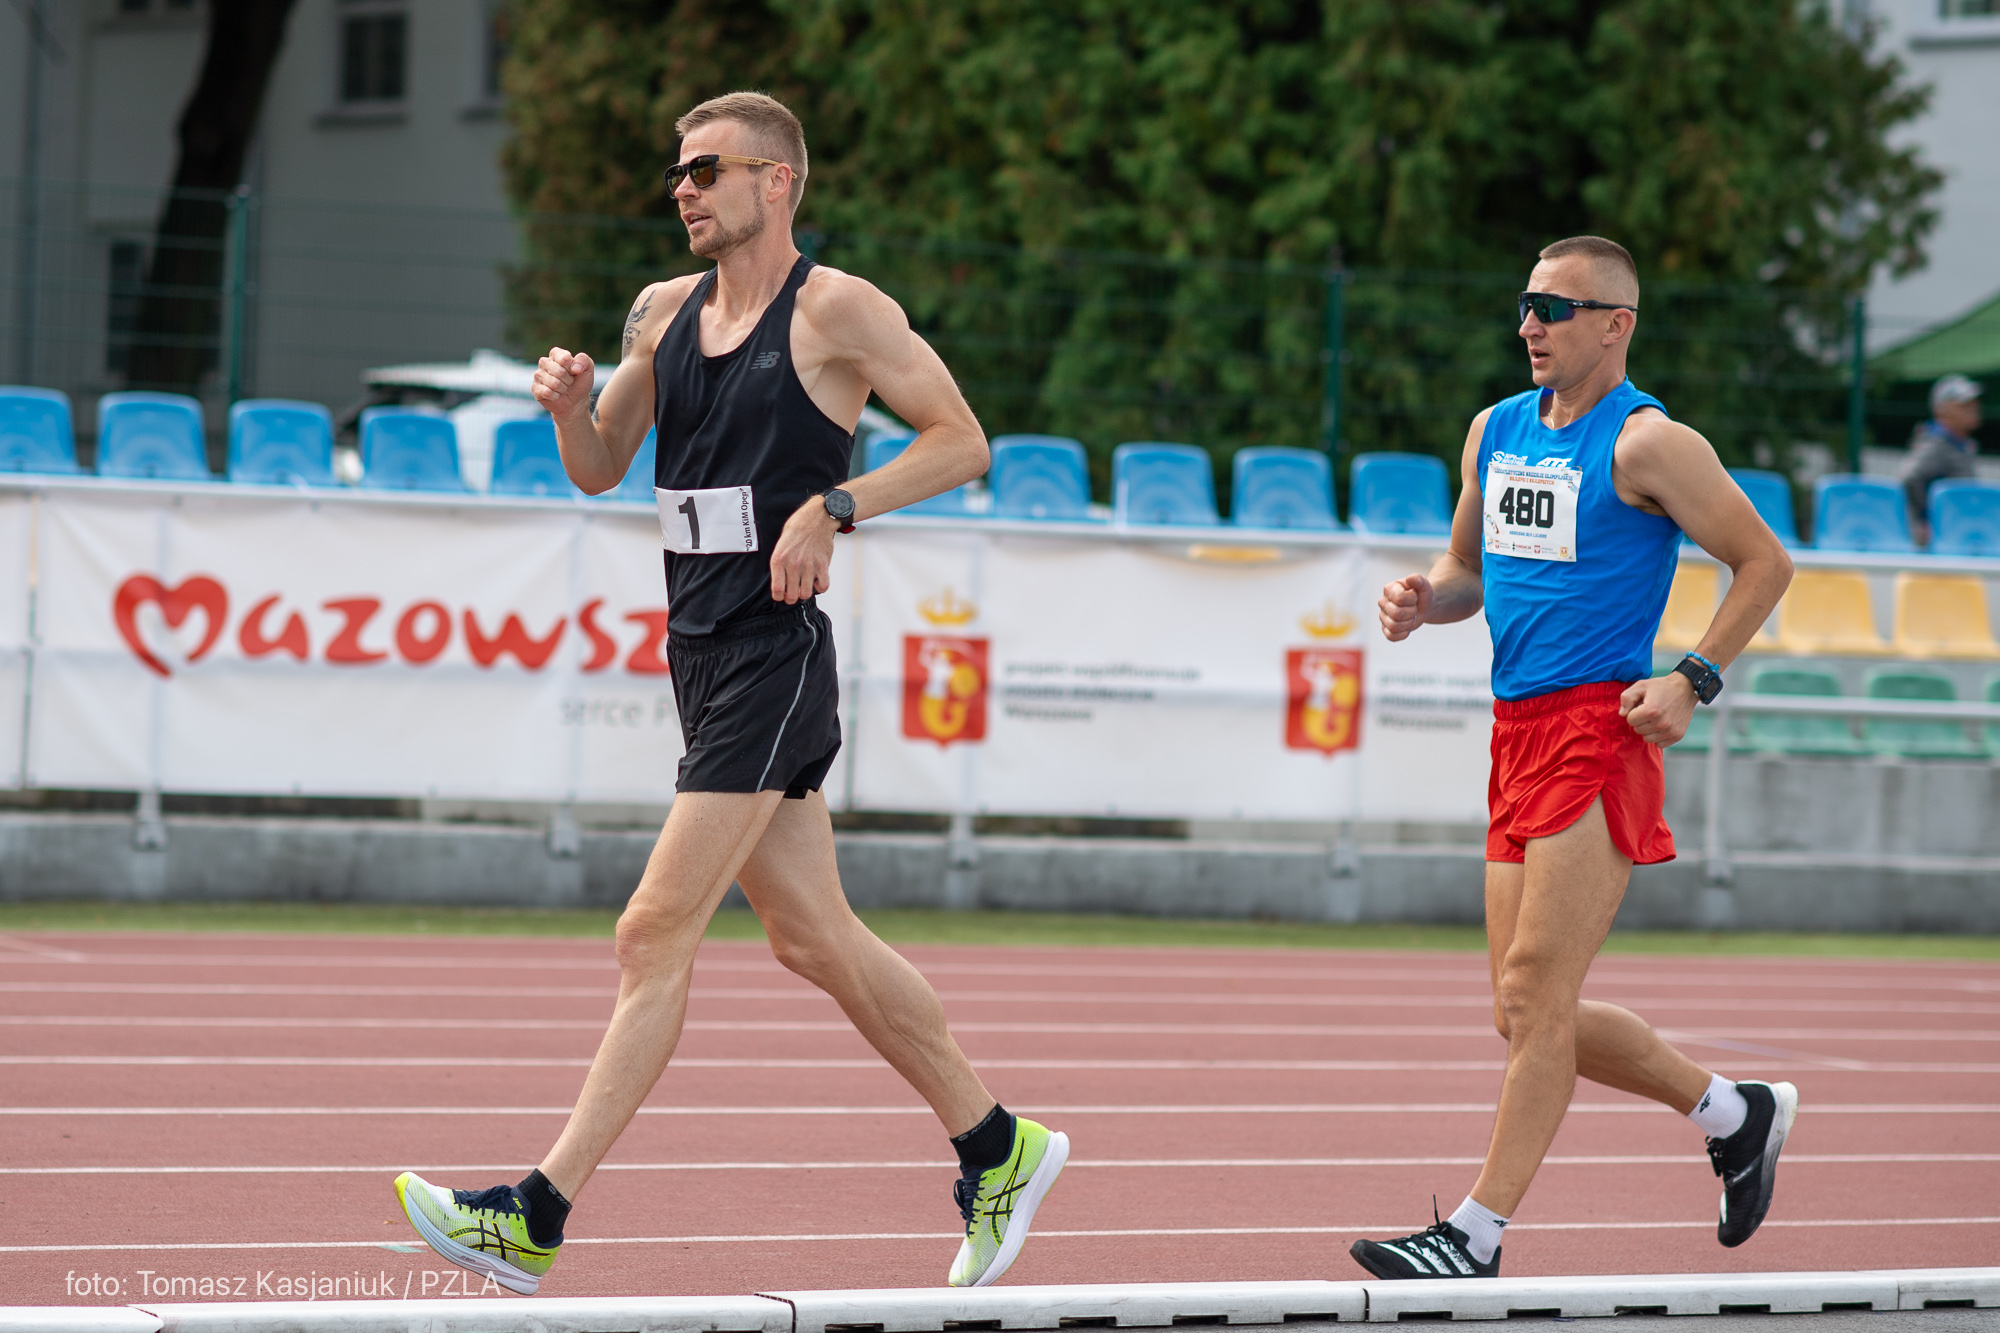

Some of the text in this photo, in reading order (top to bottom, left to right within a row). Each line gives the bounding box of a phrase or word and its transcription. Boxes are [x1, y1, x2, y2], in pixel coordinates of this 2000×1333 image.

[678, 496, 700, 550] 1
[742, 511, 750, 526] KiM
[1499, 486, 1555, 529] 480
[744, 526, 752, 539] km
[113, 572, 668, 679] Mazowsz
[560, 696, 643, 727] serce
